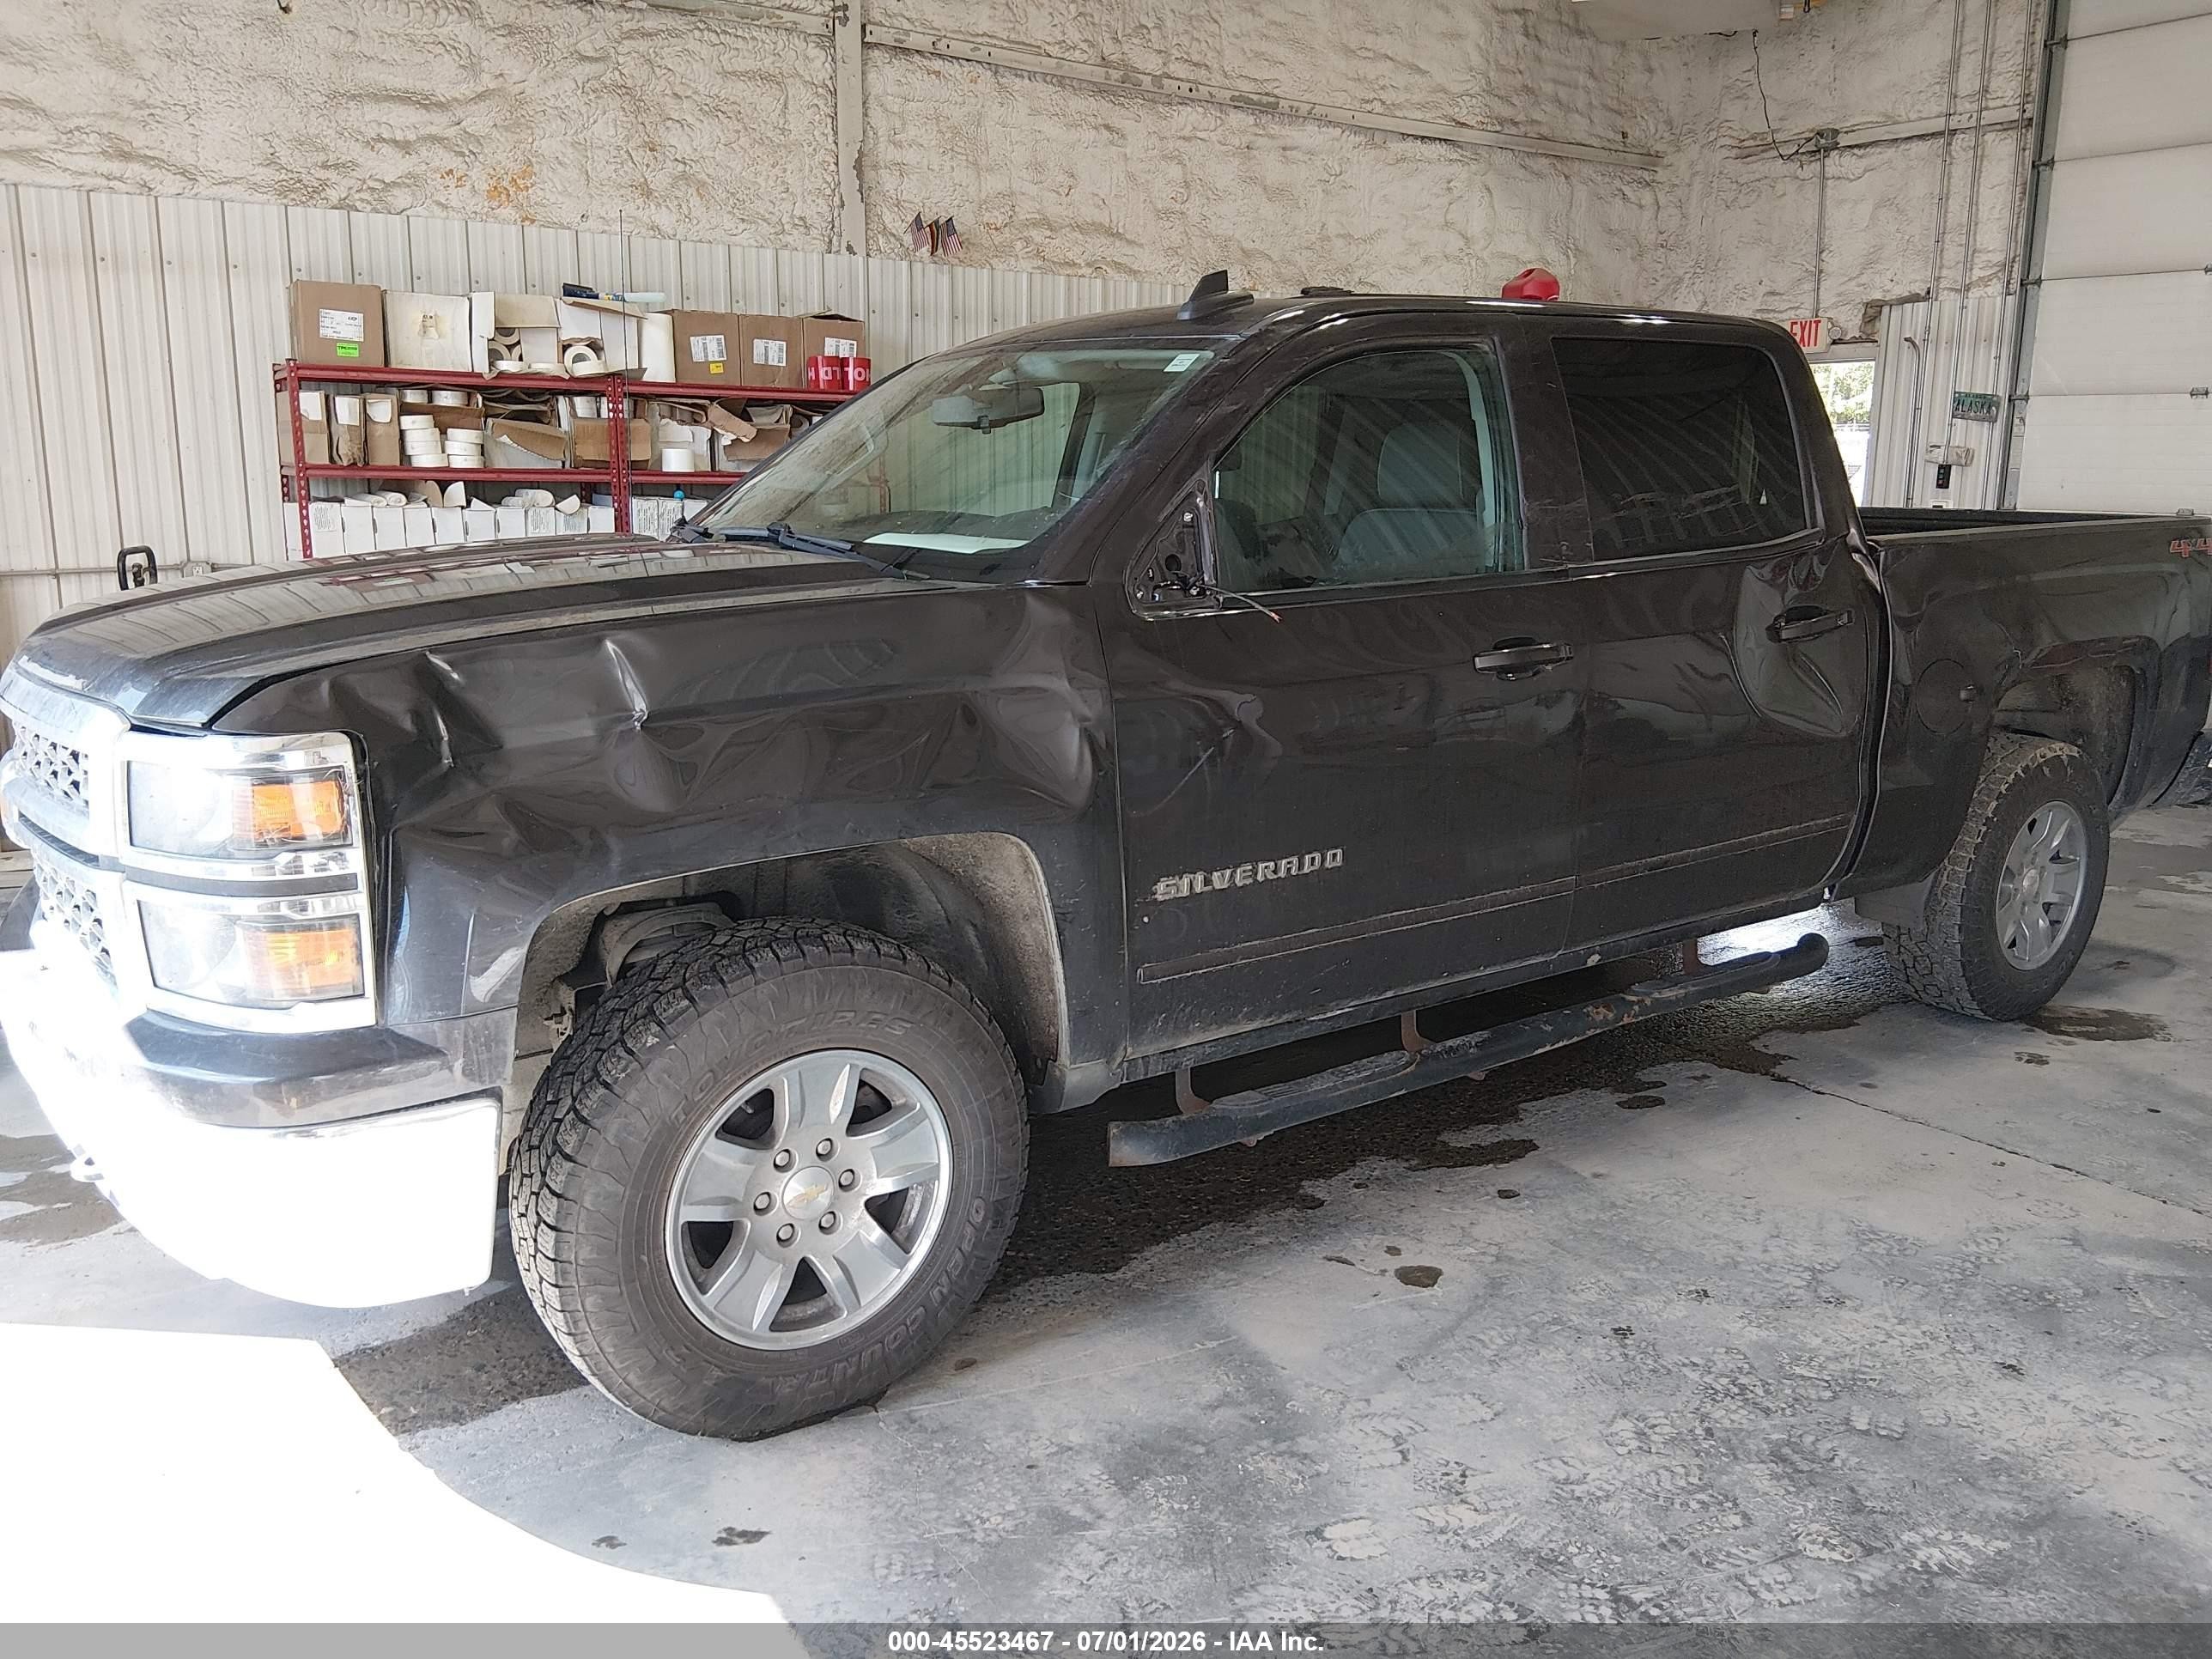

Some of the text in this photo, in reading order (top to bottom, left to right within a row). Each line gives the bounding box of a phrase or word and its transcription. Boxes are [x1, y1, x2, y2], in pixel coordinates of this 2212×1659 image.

[1790, 319, 1821, 348] EXIT
[1954, 398, 1993, 415] ALASKA
[1152, 848, 1344, 901] SILVERADO
[929, 1196, 986, 1308] OPEN
